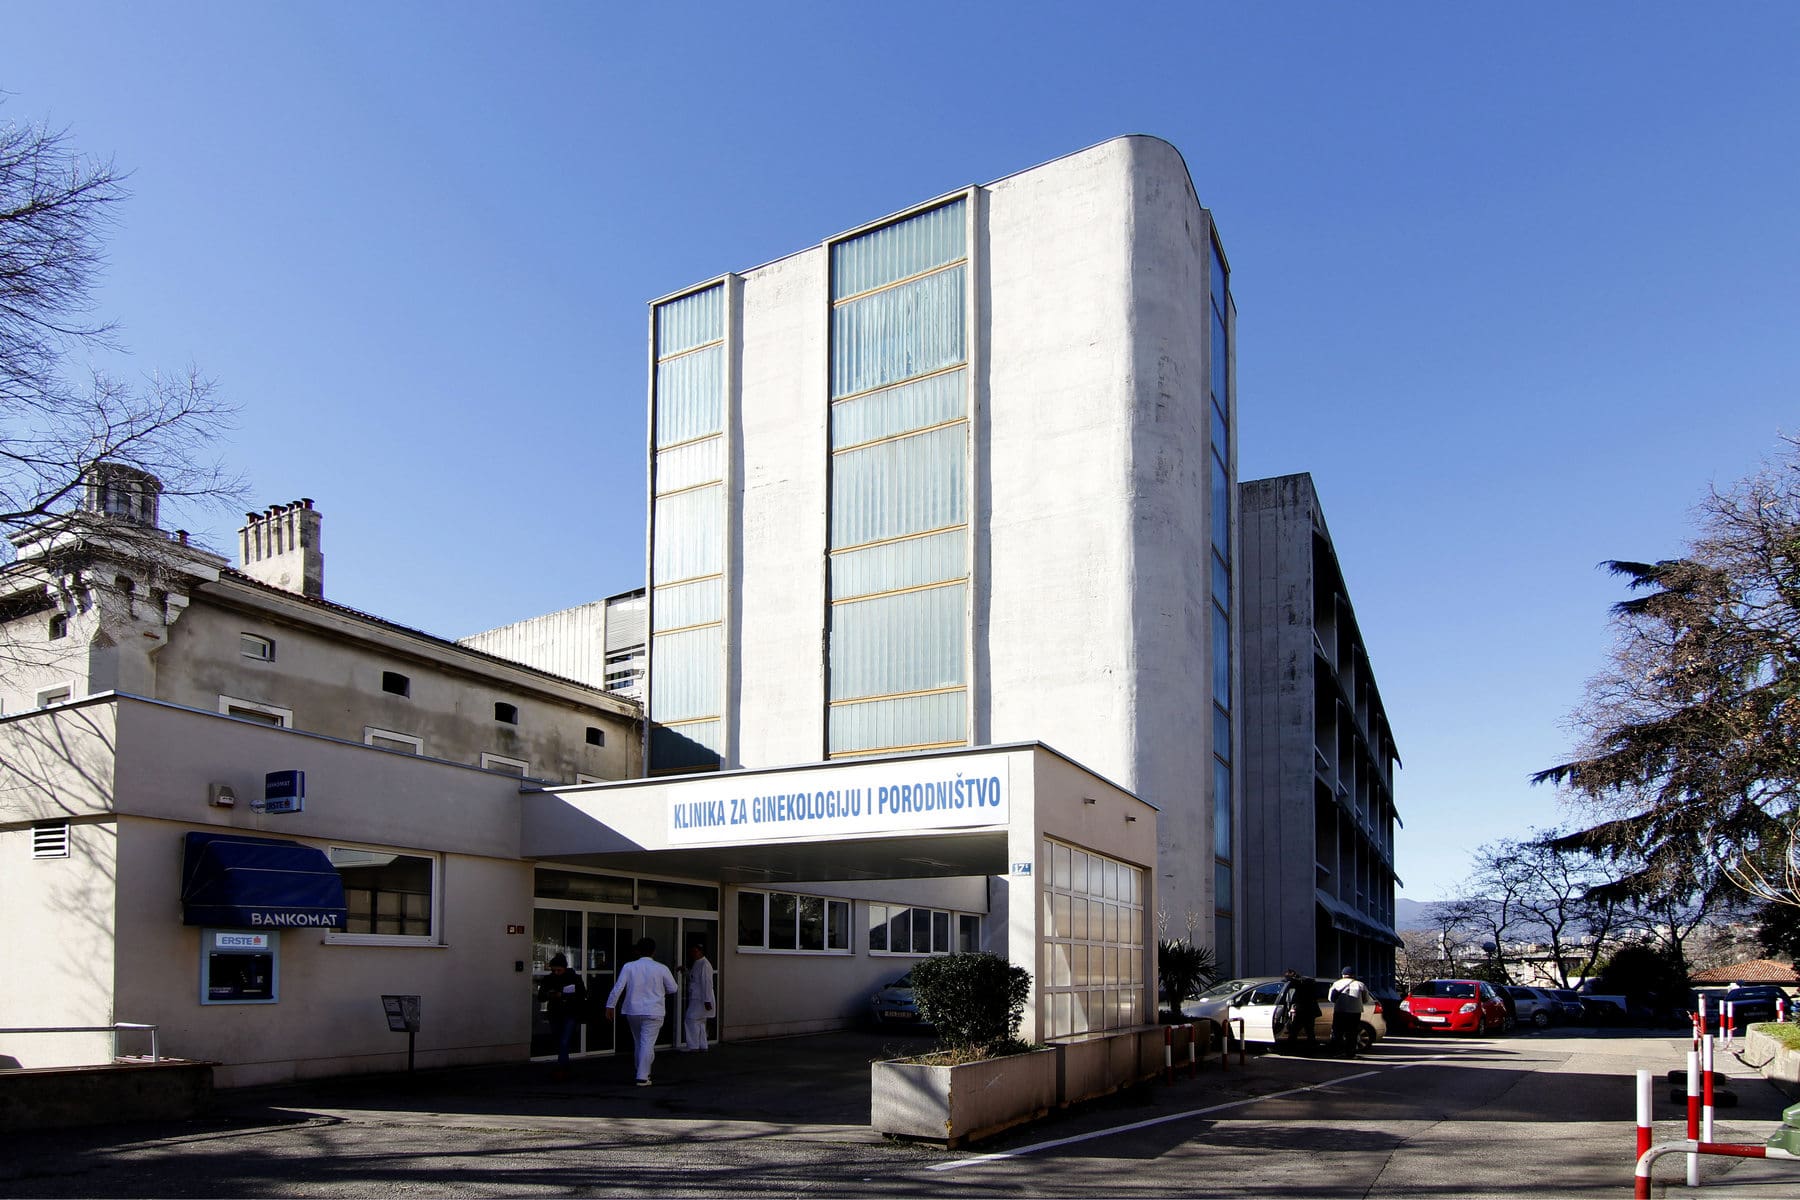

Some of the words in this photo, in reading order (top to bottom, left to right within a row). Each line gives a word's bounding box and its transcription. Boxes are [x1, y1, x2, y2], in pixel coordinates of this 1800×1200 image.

[674, 800, 726, 829] KLINIKA
[730, 798, 748, 825] ZA
[752, 788, 861, 824] GINEKOLOGIJU
[867, 787, 872, 815] I
[878, 772, 1001, 815] PORODNIŠTVO
[251, 913, 338, 926] BANKOMAT
[221, 936, 253, 945] ERSTE
